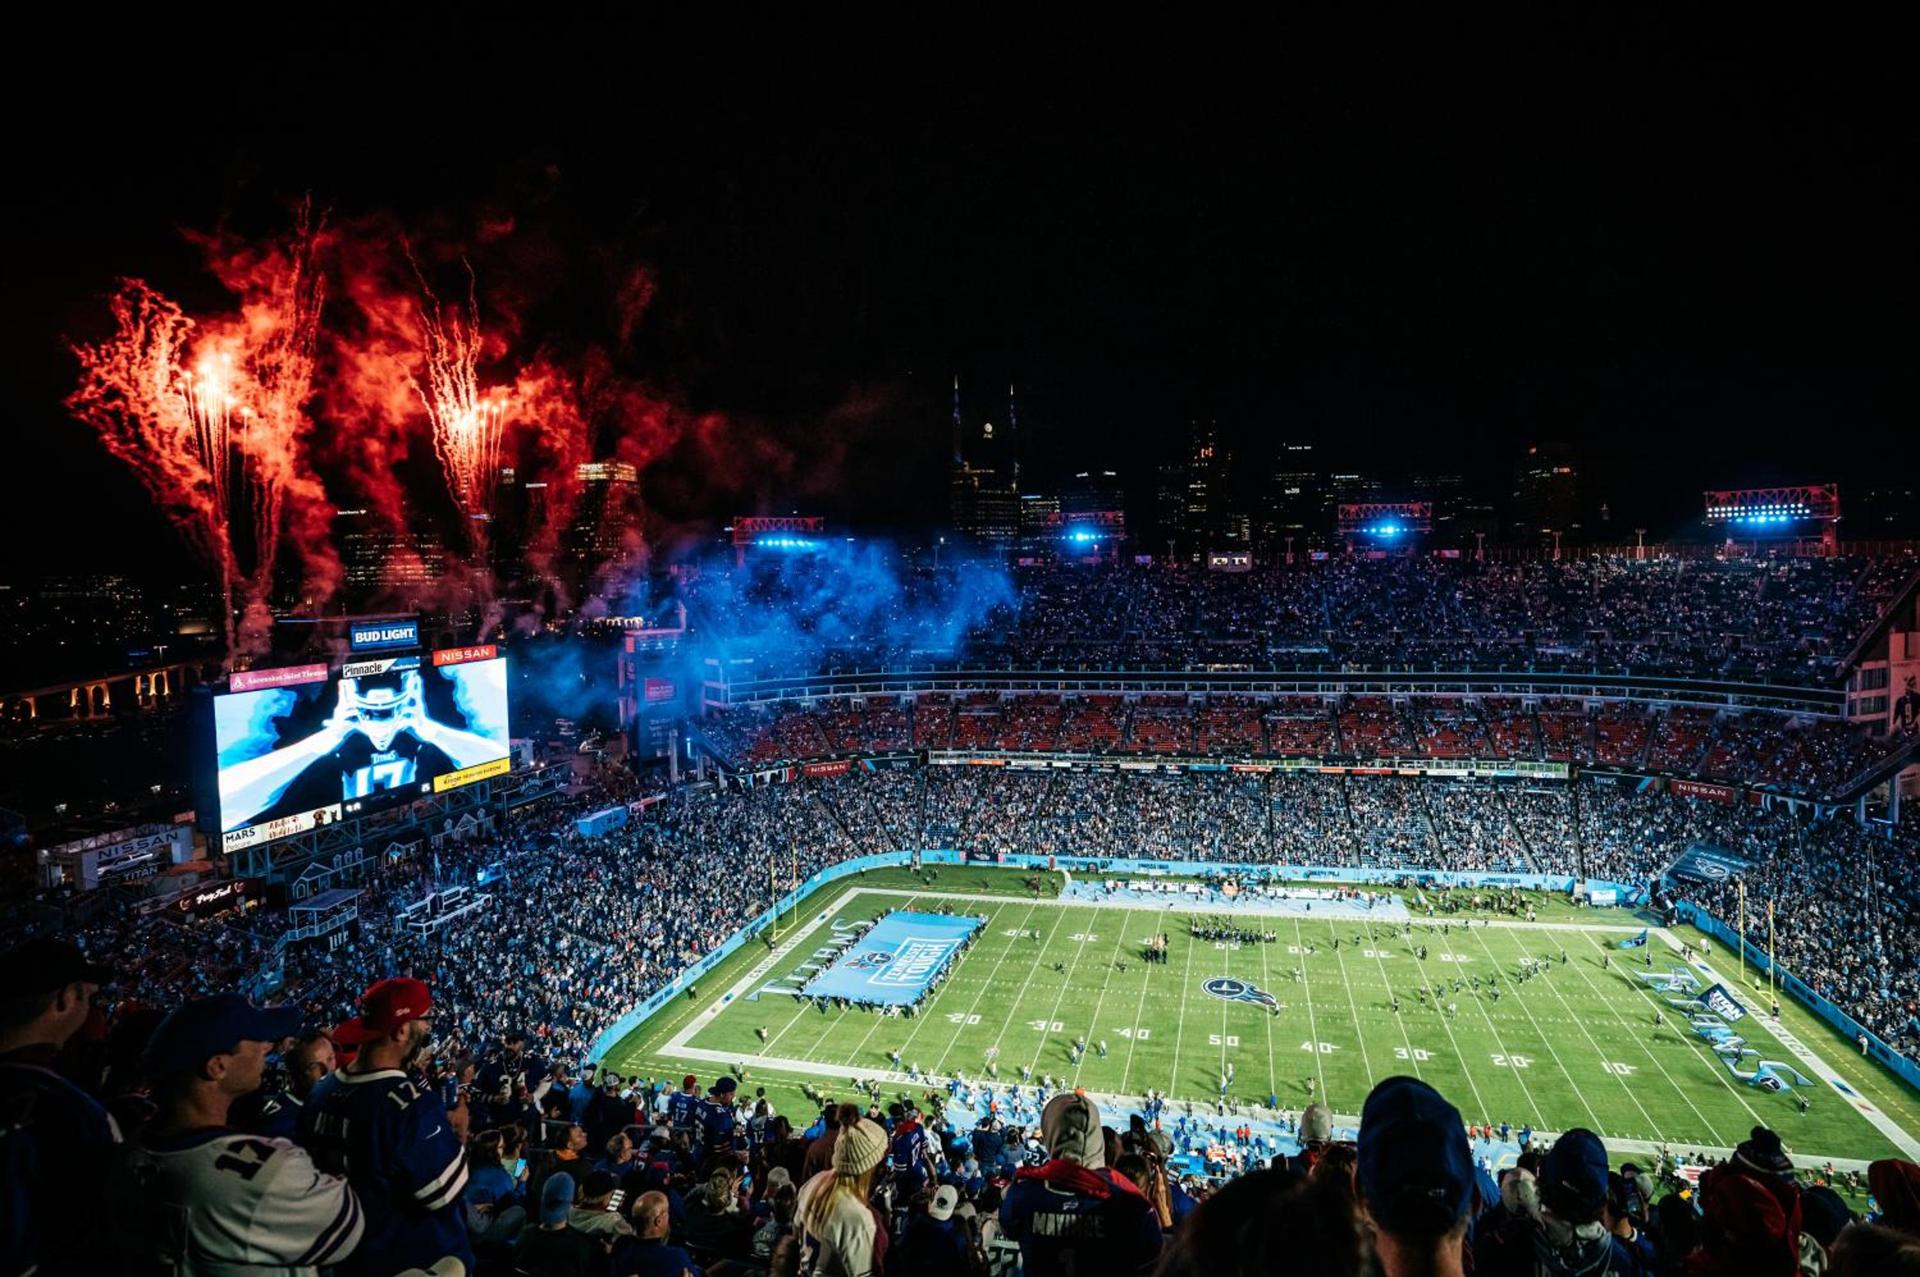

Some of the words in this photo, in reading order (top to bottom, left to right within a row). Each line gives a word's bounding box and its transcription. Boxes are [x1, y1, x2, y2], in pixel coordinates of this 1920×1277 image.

[355, 631, 381, 644] BUD
[381, 627, 414, 641] LIGHT
[441, 648, 489, 661] NISSAN
[344, 662, 383, 677] Pinnacle
[810, 764, 846, 773] NISSAN
[1678, 784, 1727, 797] NISSAN
[225, 828, 256, 844] MARS
[98, 832, 179, 860] NISSAN
[124, 867, 158, 881] TITAN
[898, 943, 951, 982] TOUGH
[949, 1012, 983, 1026] 20
[1033, 1020, 1065, 1033] 30
[1119, 1027, 1152, 1040] 40
[1208, 1034, 1241, 1047] 50
[1300, 1040, 1333, 1054] 40
[1394, 1047, 1429, 1061] 30
[1490, 1054, 1530, 1069] 20
[1600, 1060, 1633, 1075] 10
[386, 1079, 422, 1111] 17
